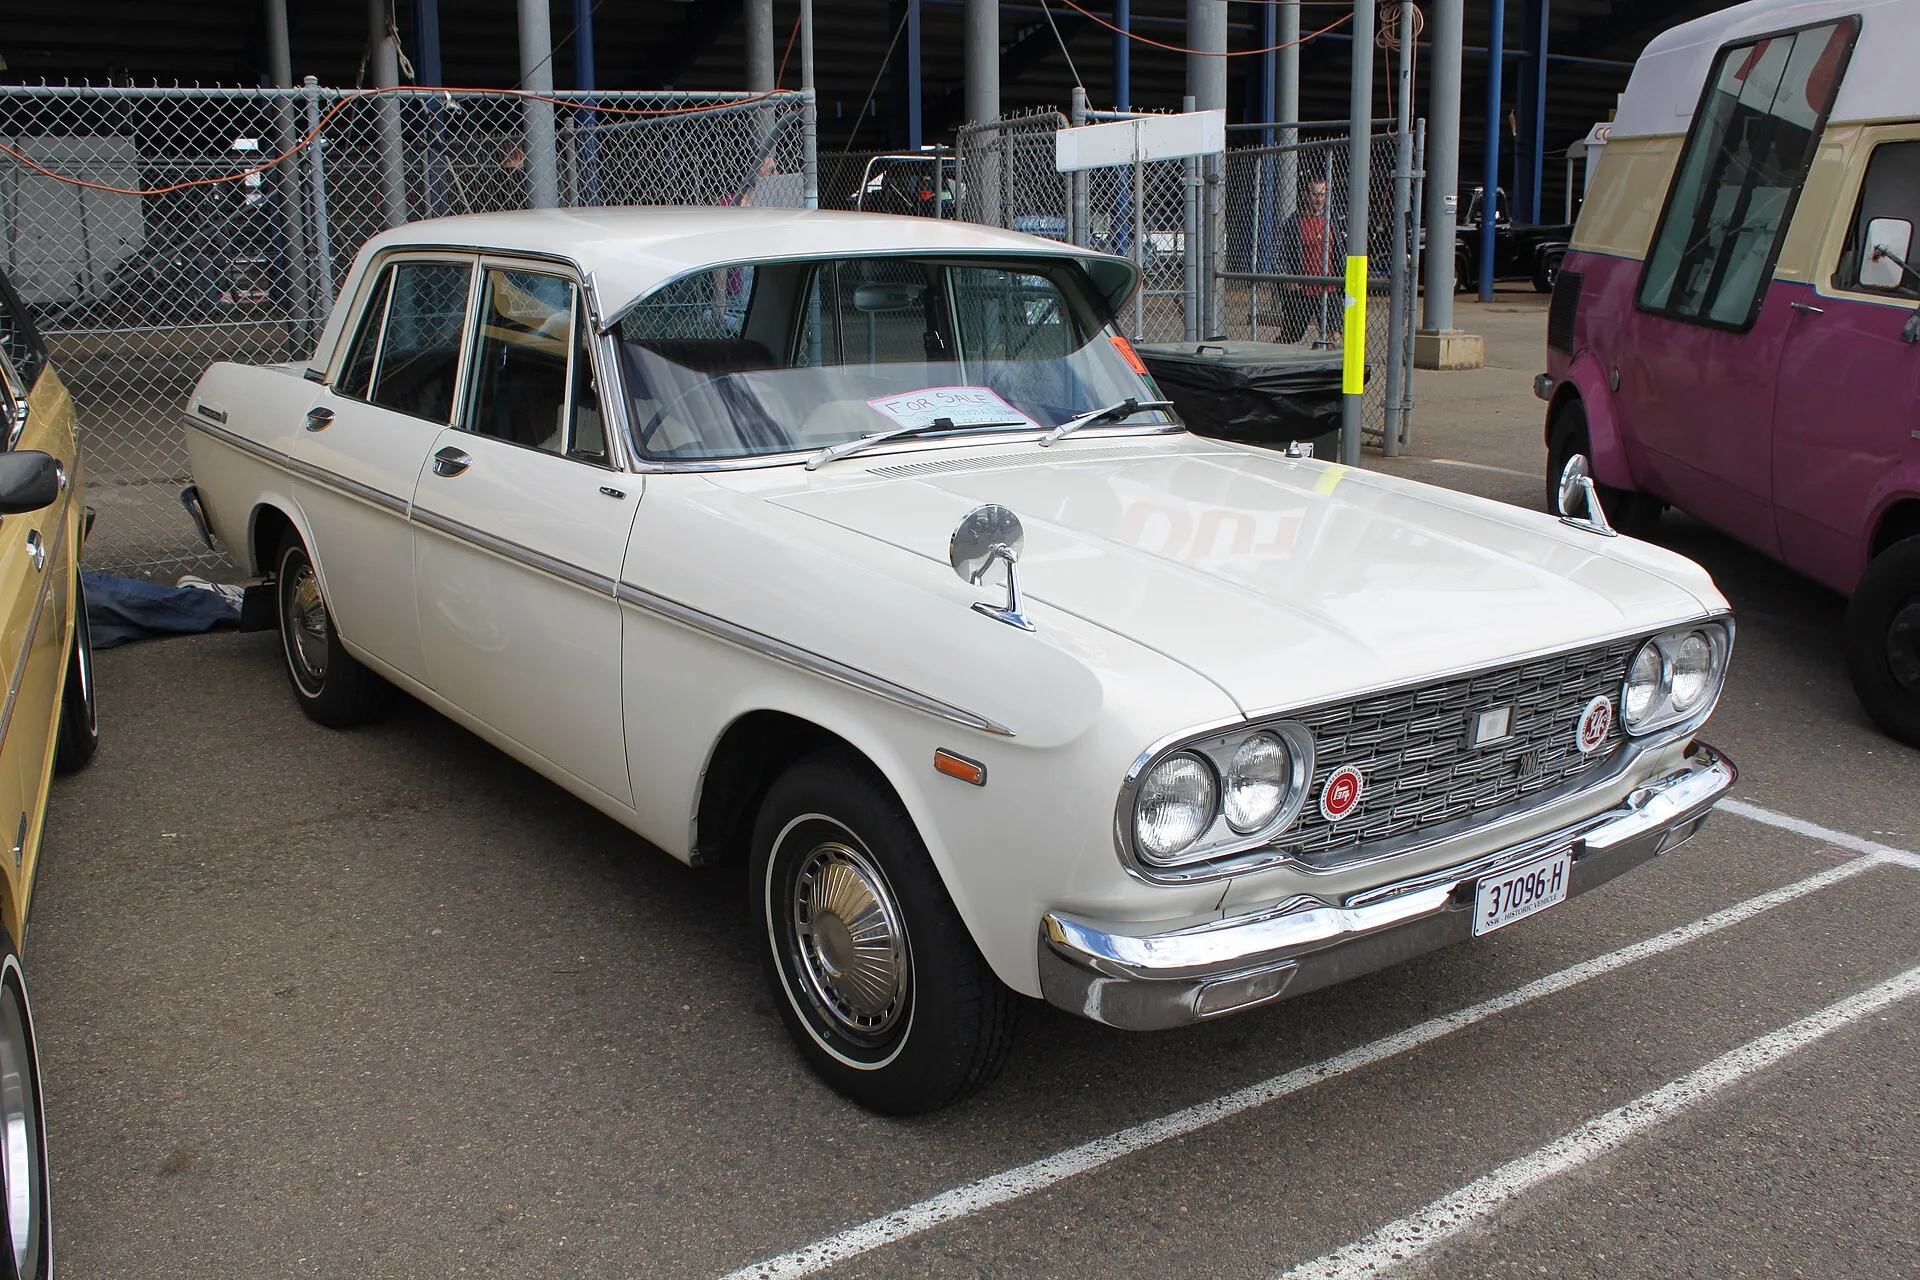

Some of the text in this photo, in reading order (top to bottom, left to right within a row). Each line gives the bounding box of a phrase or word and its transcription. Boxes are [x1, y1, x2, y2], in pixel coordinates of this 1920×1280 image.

[885, 392, 989, 414] FOR SALE
[1485, 917, 1501, 928] NSW
[1504, 904, 1534, 922] HISTORIC
[1533, 893, 1559, 910] VEHICLE
